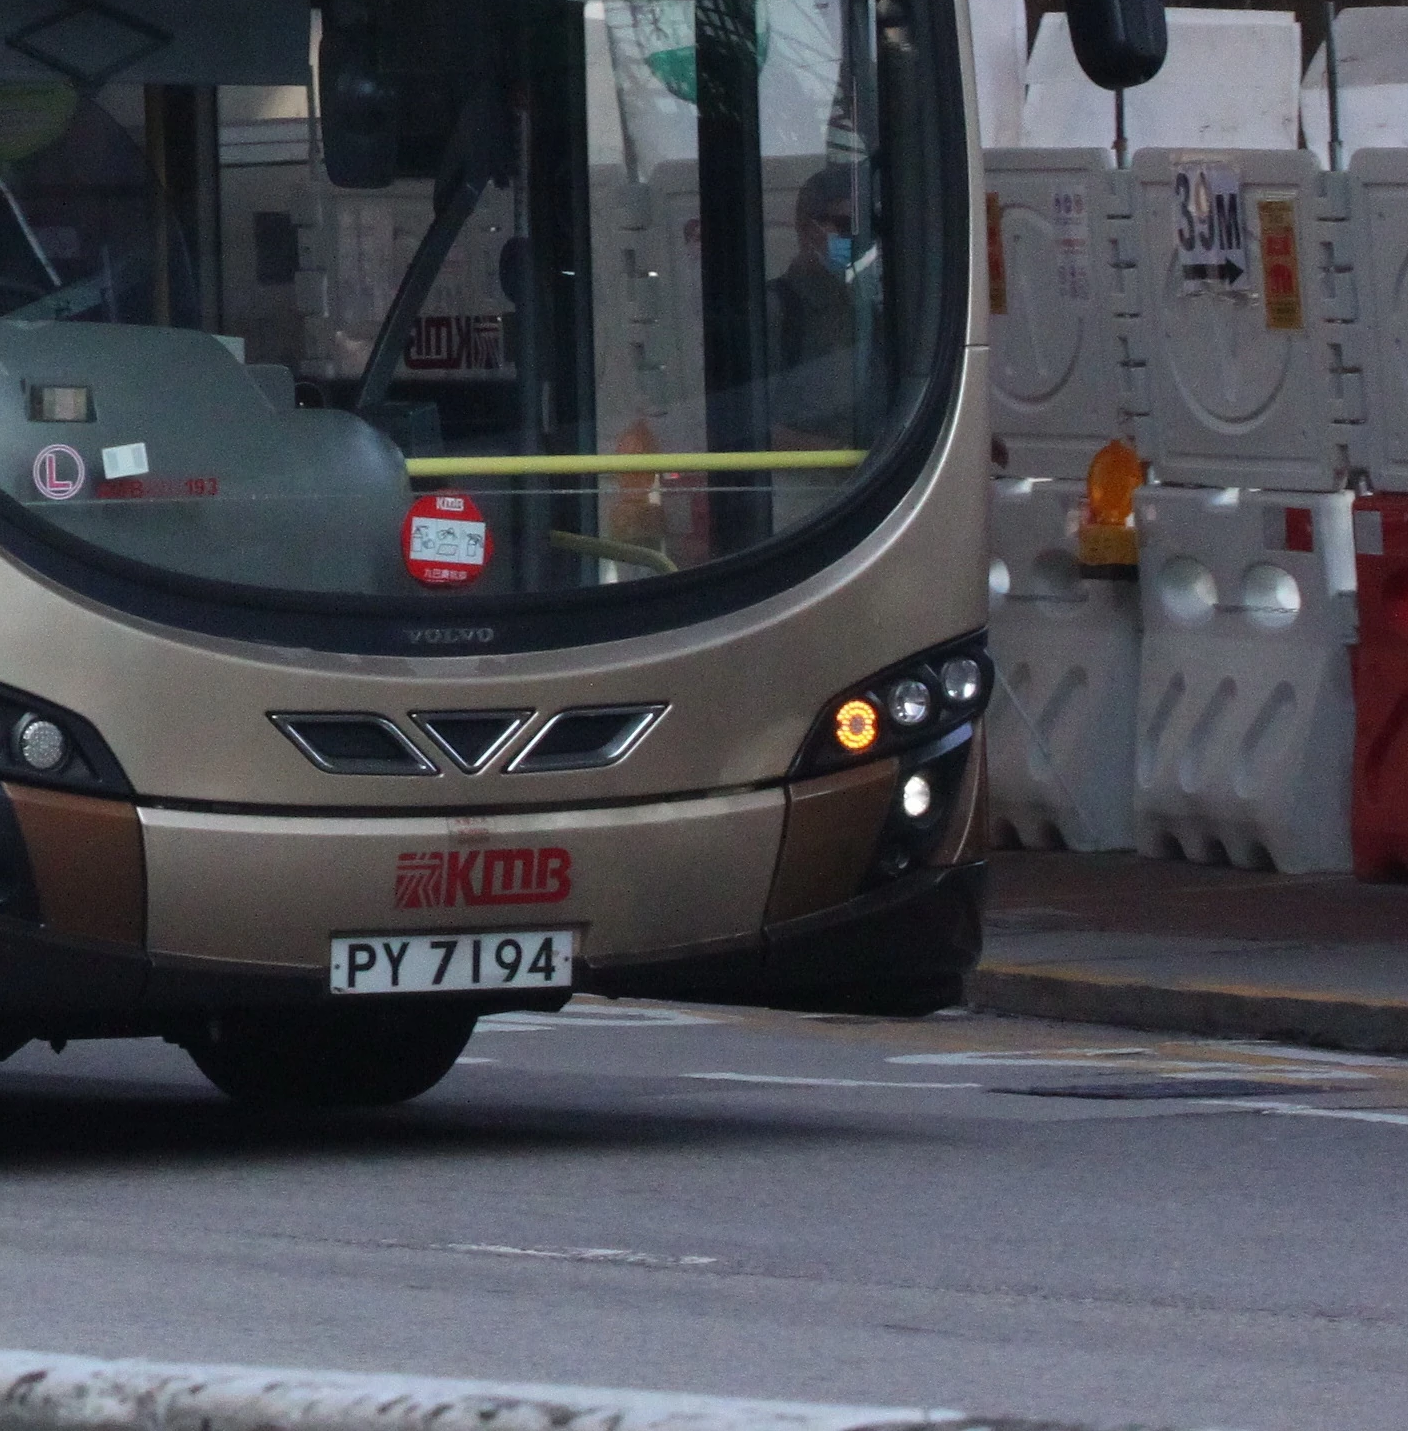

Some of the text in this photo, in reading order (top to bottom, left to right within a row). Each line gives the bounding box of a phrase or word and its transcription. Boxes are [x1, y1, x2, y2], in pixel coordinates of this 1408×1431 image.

[1174, 172, 1243, 252] 39M
[404, 626, 495, 645] VOLVO
[443, 846, 573, 909] KMB
[347, 936, 557, 988] PY 7194
